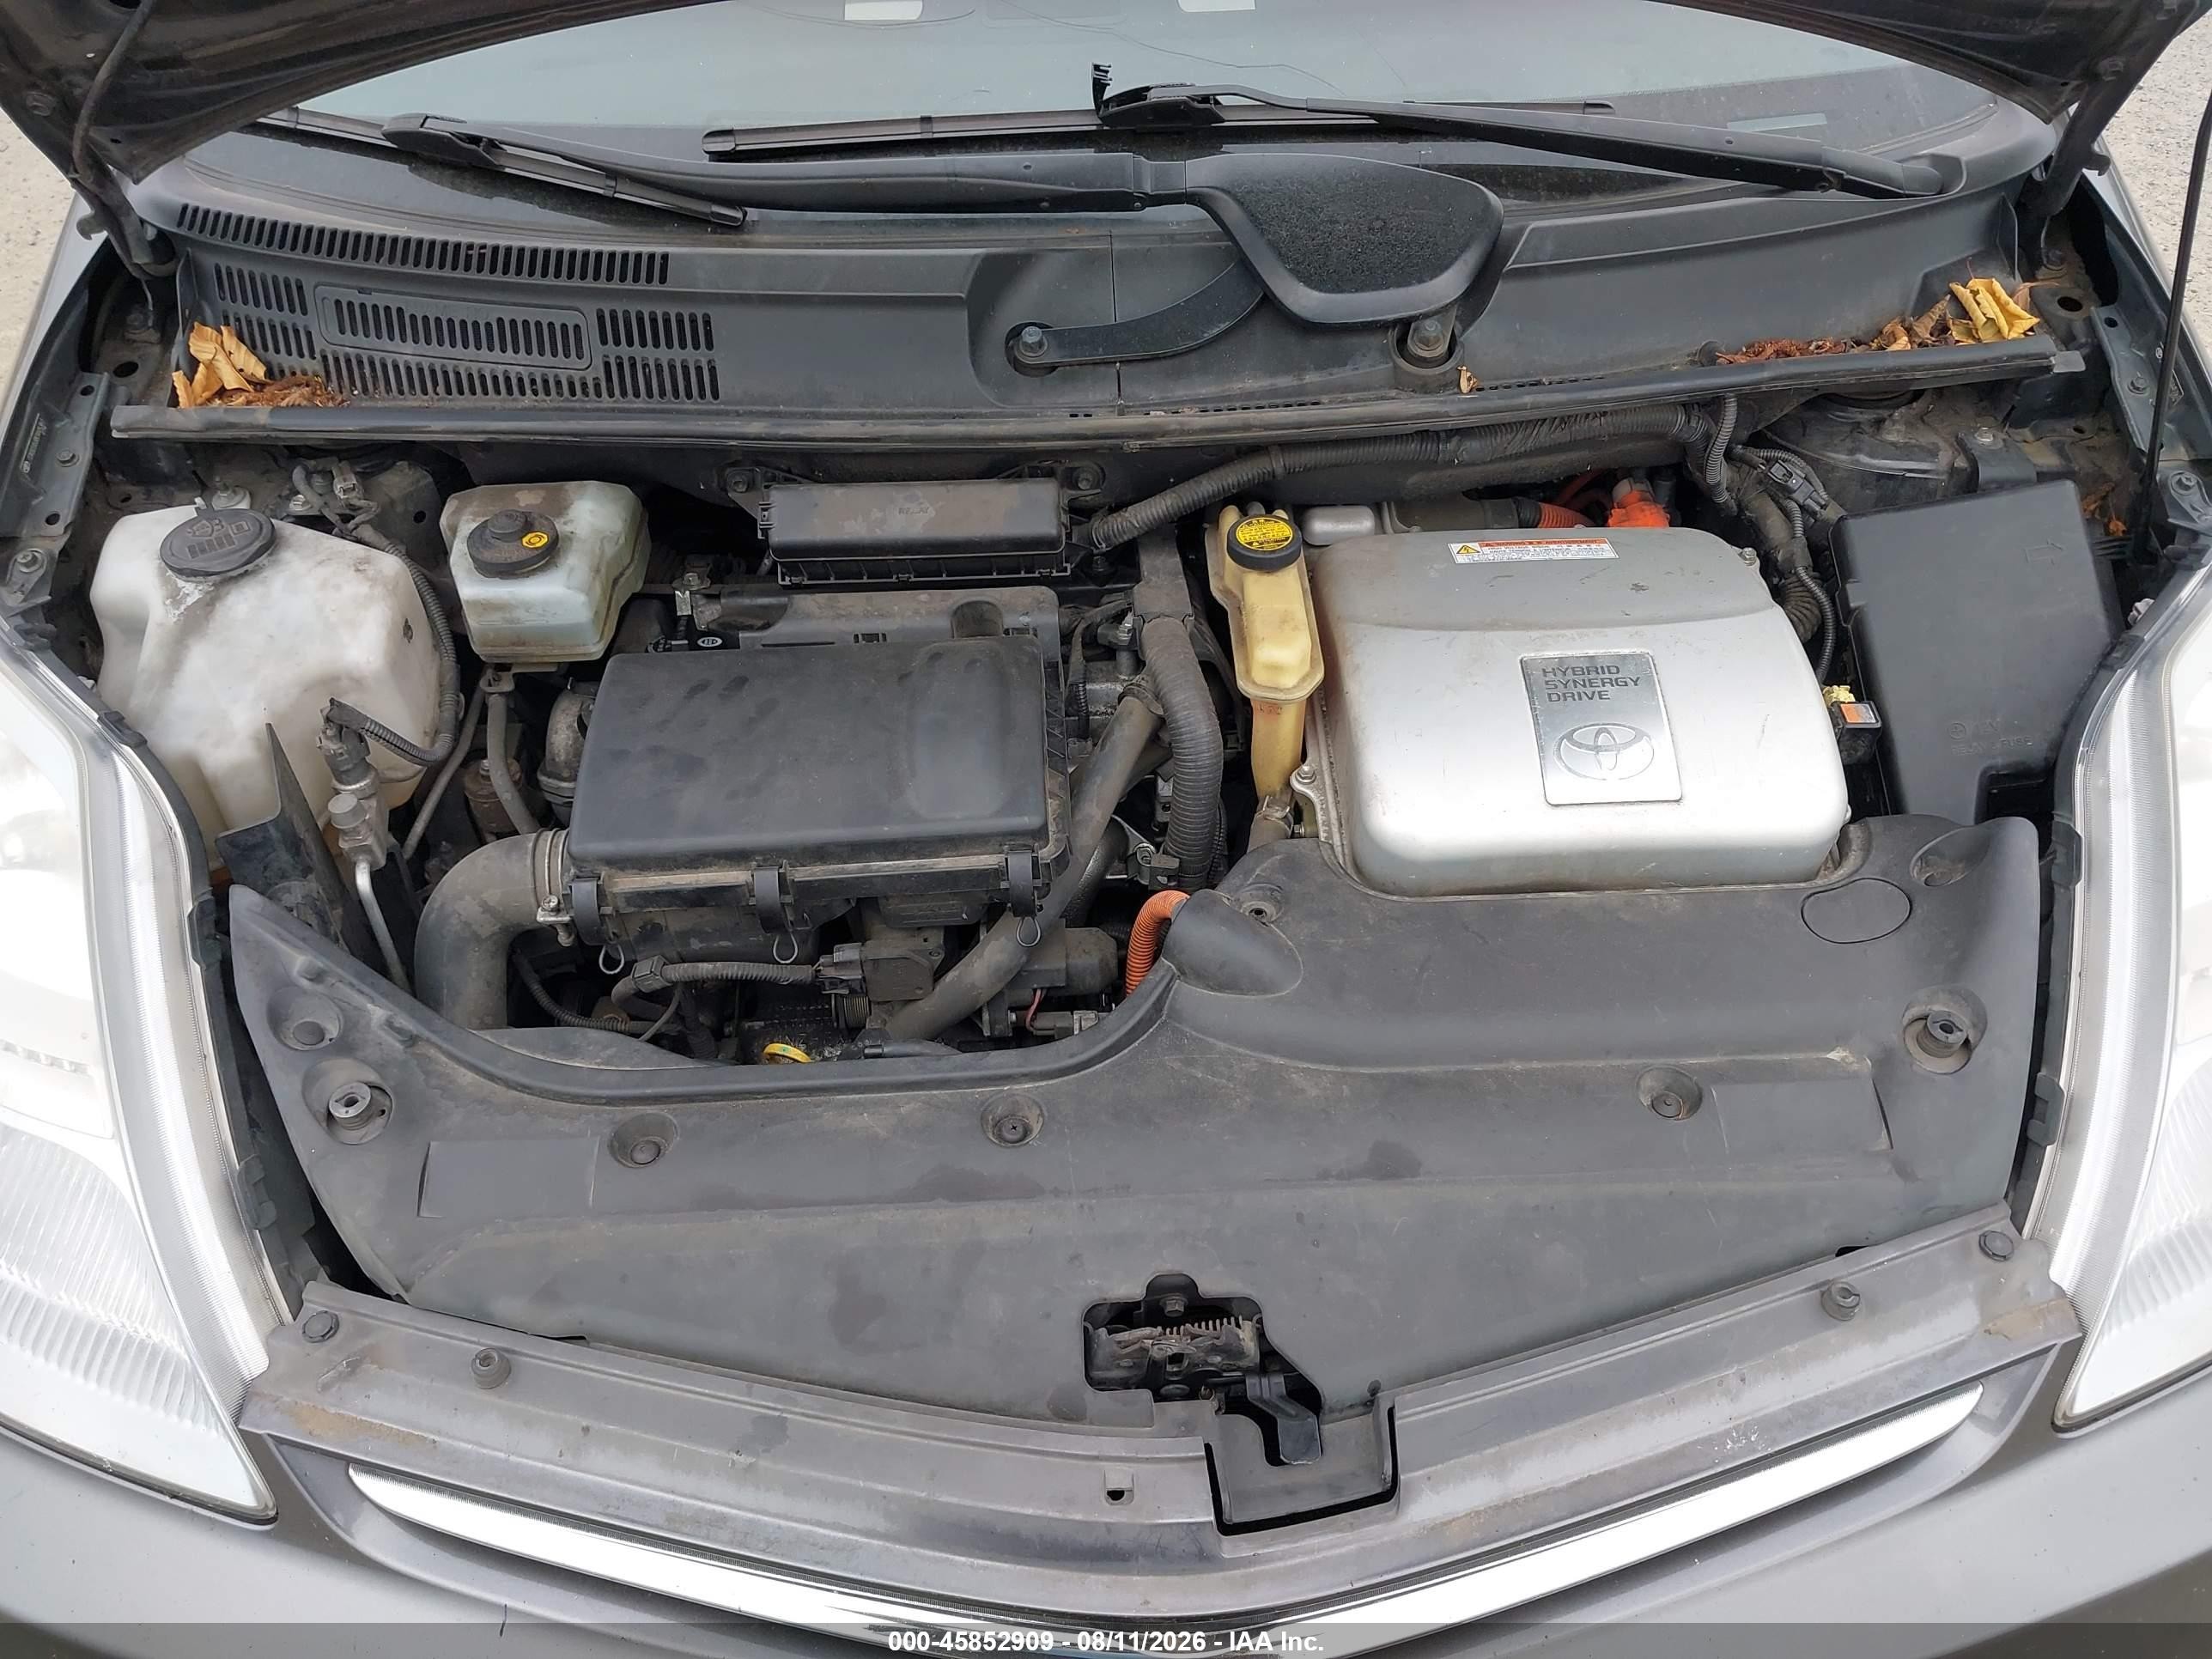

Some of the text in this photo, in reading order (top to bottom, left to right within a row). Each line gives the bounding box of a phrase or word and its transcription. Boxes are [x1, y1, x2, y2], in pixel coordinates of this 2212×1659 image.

[1542, 665, 1620, 678] HYBRID
[1545, 677, 1640, 690] SYNERGY
[1547, 690, 1611, 702] DRIVE
[2000, 736, 2034, 748] FUSE
